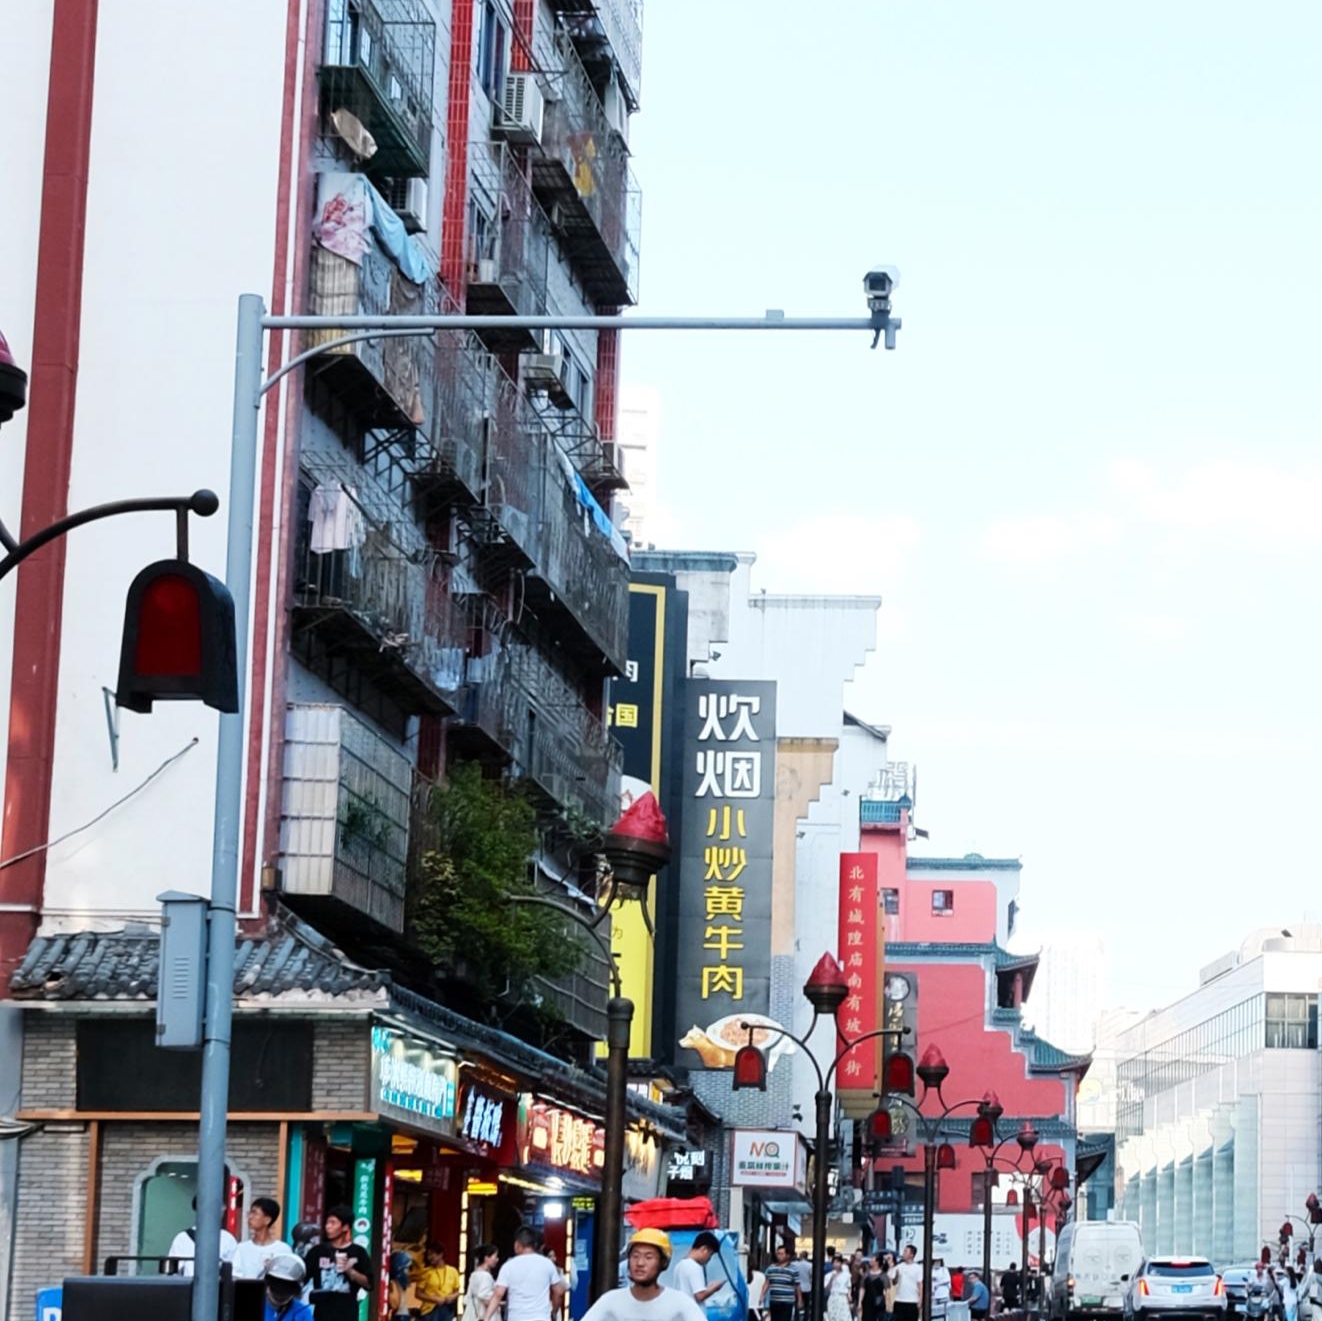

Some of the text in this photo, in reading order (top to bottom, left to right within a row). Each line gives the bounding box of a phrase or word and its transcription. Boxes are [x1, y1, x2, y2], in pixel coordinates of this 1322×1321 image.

[695, 692, 762, 799] 炊烟
[701, 805, 747, 1000] 小炒黄牛肉
